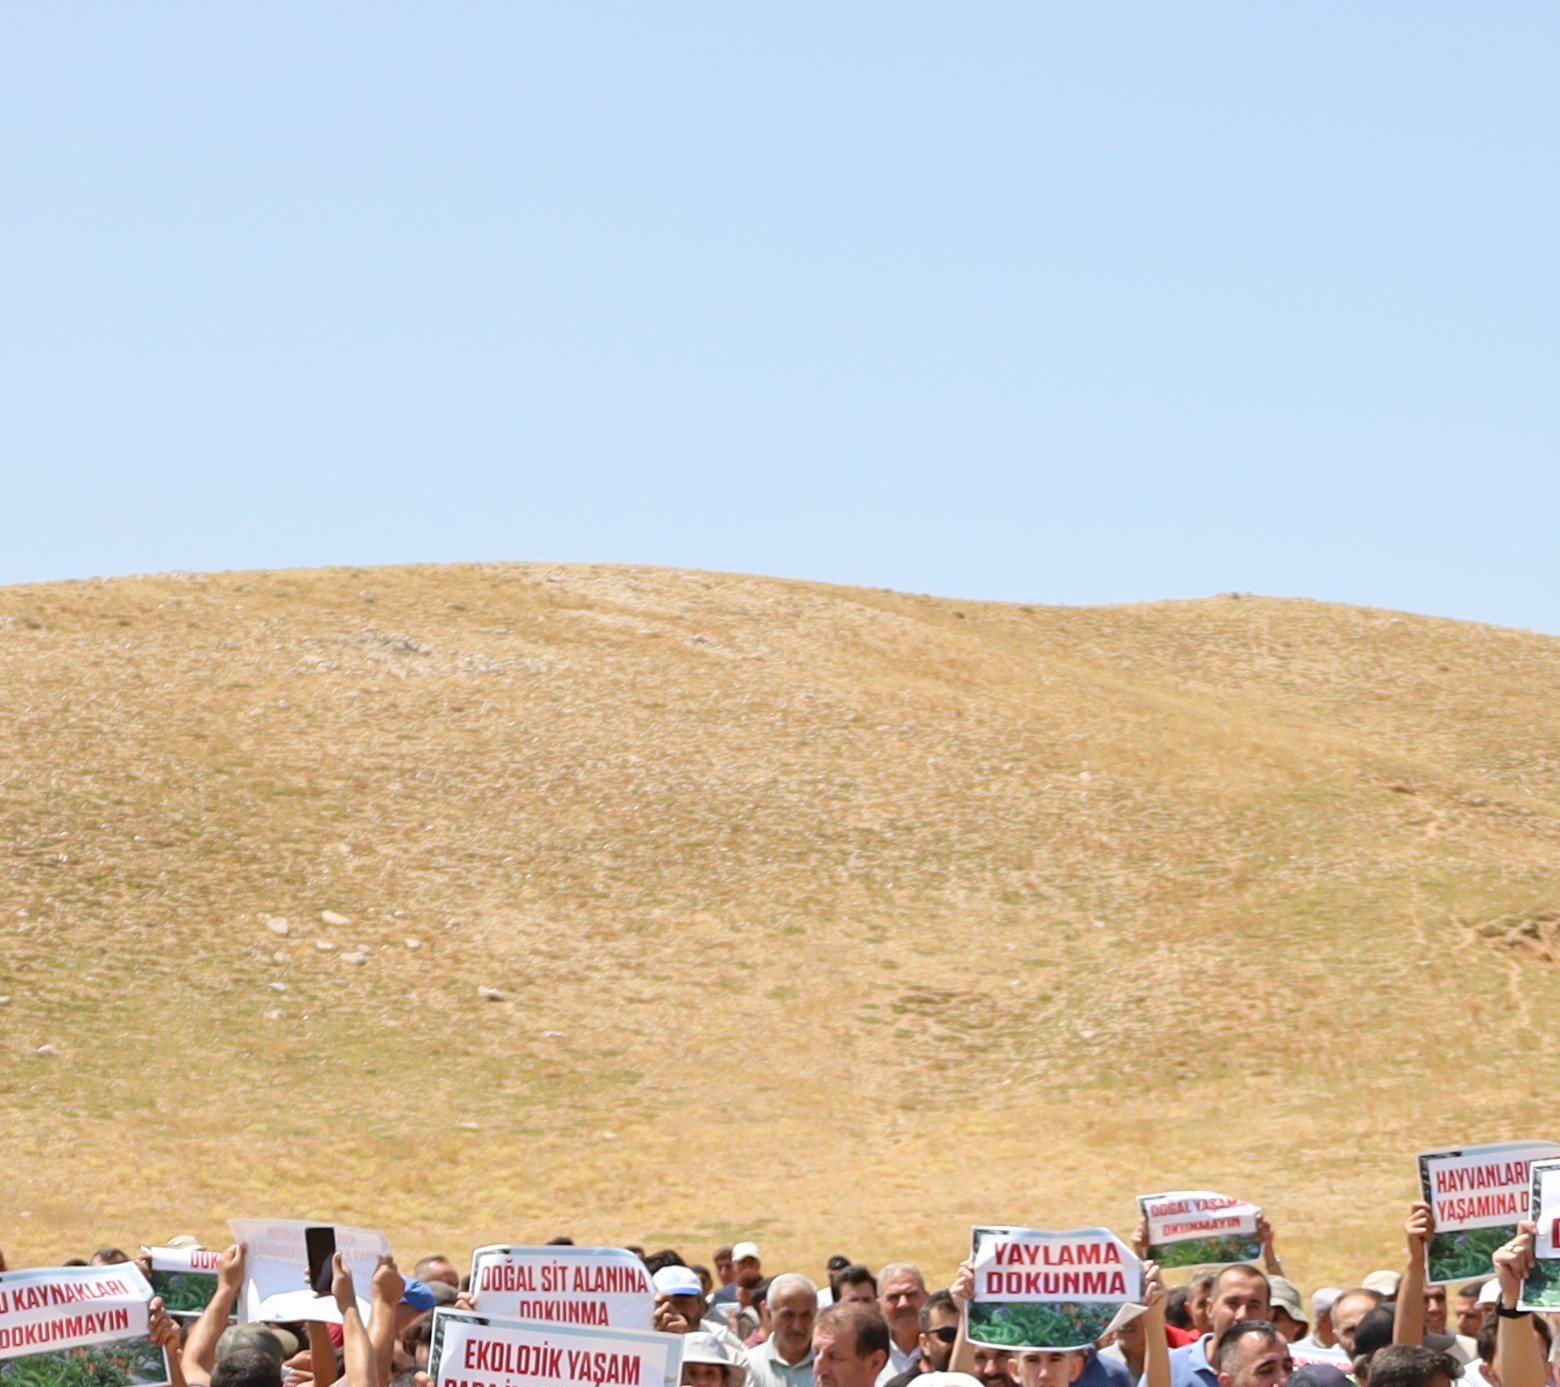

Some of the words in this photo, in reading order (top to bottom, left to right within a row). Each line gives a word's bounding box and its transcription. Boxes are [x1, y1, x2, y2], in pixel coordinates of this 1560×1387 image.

[1436, 1193, 1517, 1225] YAŞAMINA
[994, 1241, 1121, 1266] YAYLAMA
[481, 1258, 537, 1293] DOĞAL
[541, 1260, 569, 1293] SİT
[572, 1266, 649, 1294] ALANINA
[985, 1271, 1127, 1295] DOKUNMA
[14, 1279, 130, 1312] KAYNAKLARI
[464, 1338, 564, 1380] EKOLOJİK
[567, 1351, 642, 1387] YAŞAM
